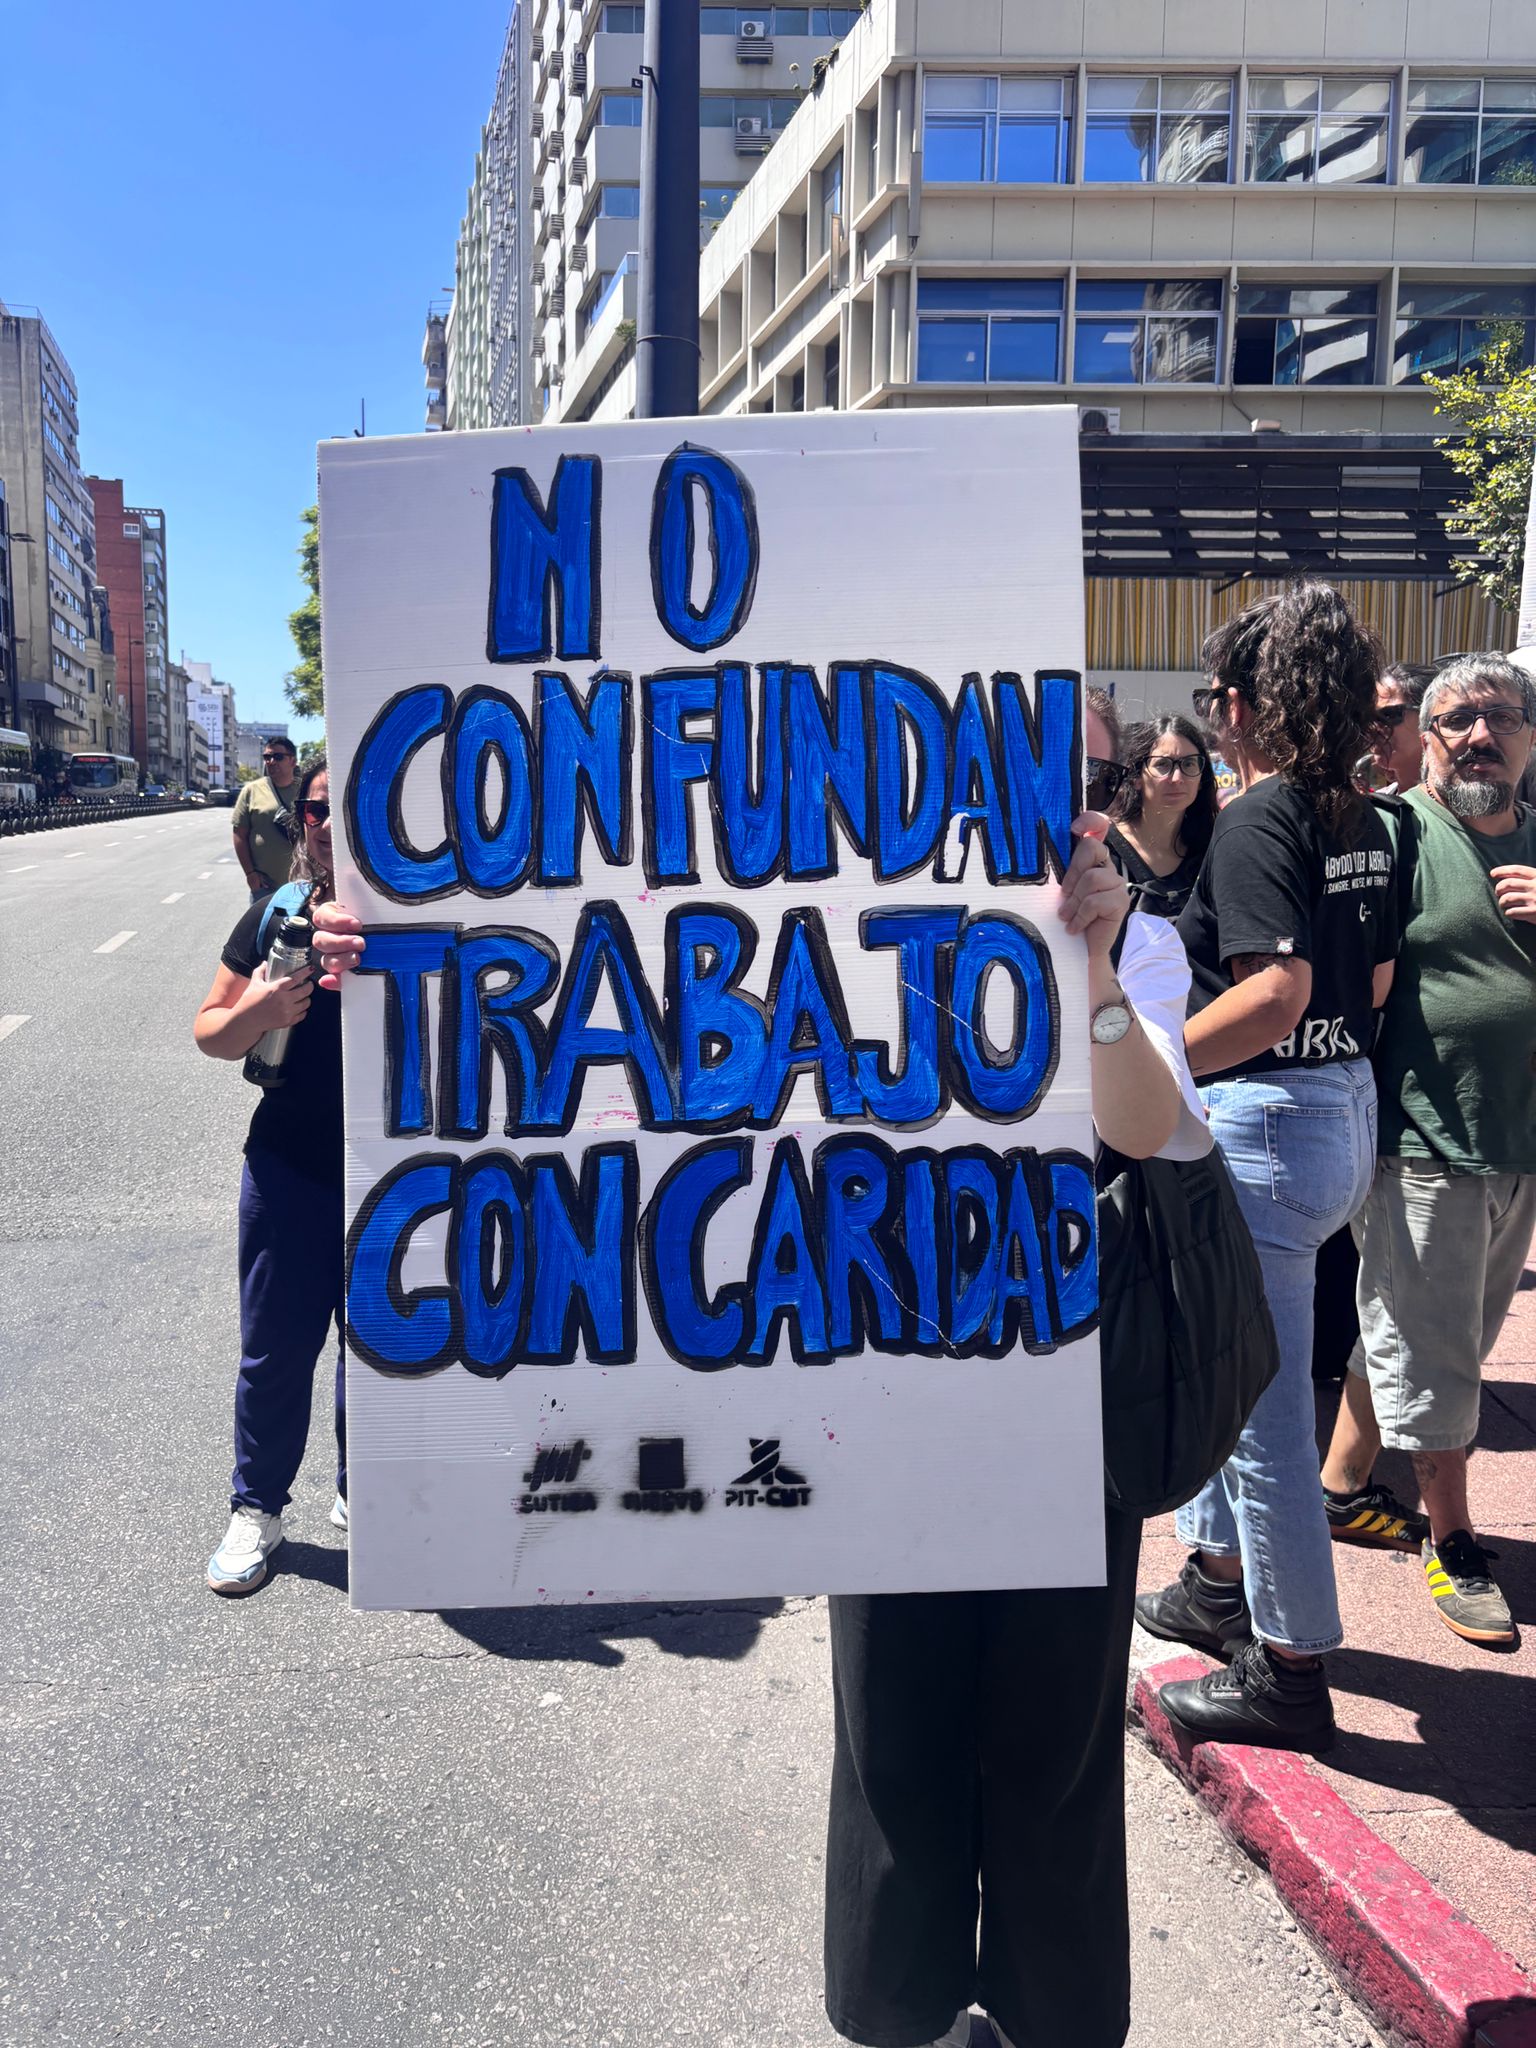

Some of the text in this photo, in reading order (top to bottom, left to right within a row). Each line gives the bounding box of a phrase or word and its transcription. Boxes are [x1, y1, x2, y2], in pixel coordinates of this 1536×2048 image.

[486, 441, 760, 662] NO
[344, 659, 1083, 904] CONFUNDAN
[351, 900, 1060, 1138] TRABAJO
[345, 1132, 1099, 1380] CON CARIDAD
